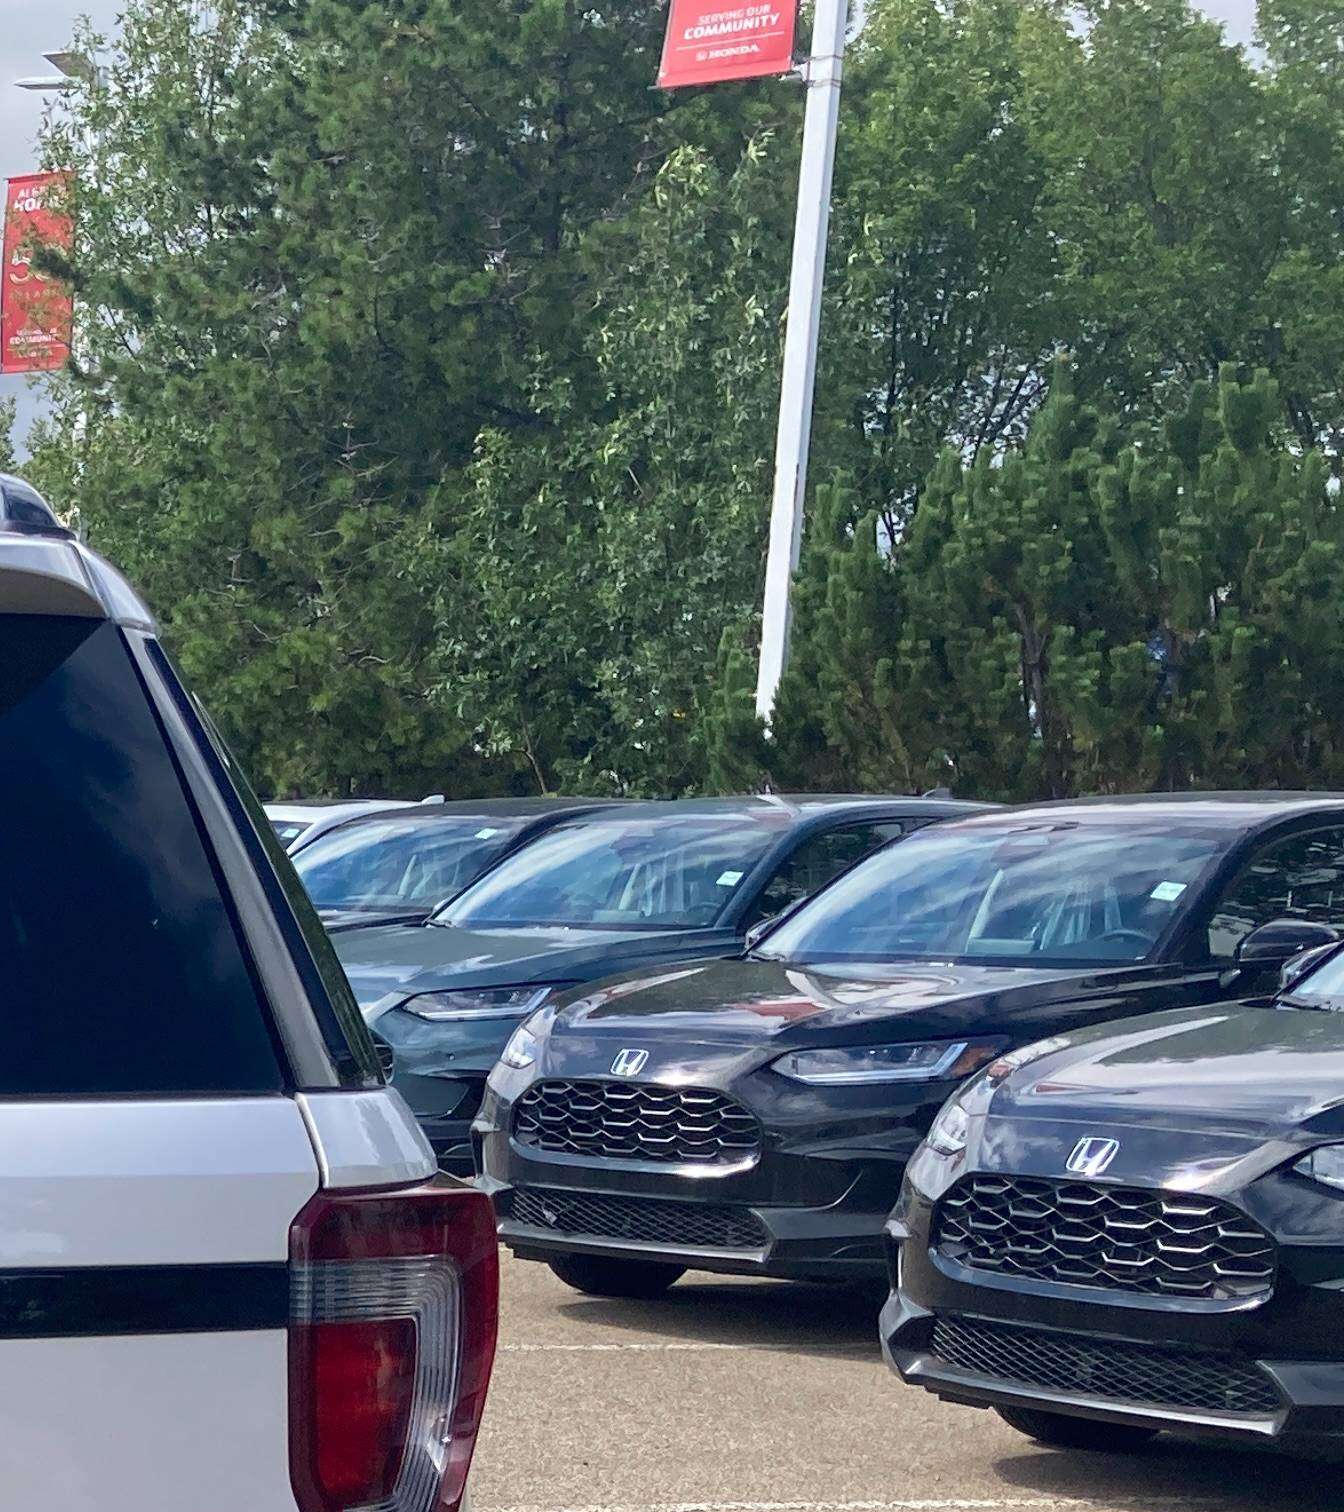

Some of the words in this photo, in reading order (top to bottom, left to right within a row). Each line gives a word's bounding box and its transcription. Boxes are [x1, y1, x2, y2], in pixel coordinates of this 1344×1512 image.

[697, 8, 745, 26] SERVING
[746, 4, 771, 16] OUR
[684, 13, 781, 40] COMMUNITY
[709, 44, 761, 61] HONDA
